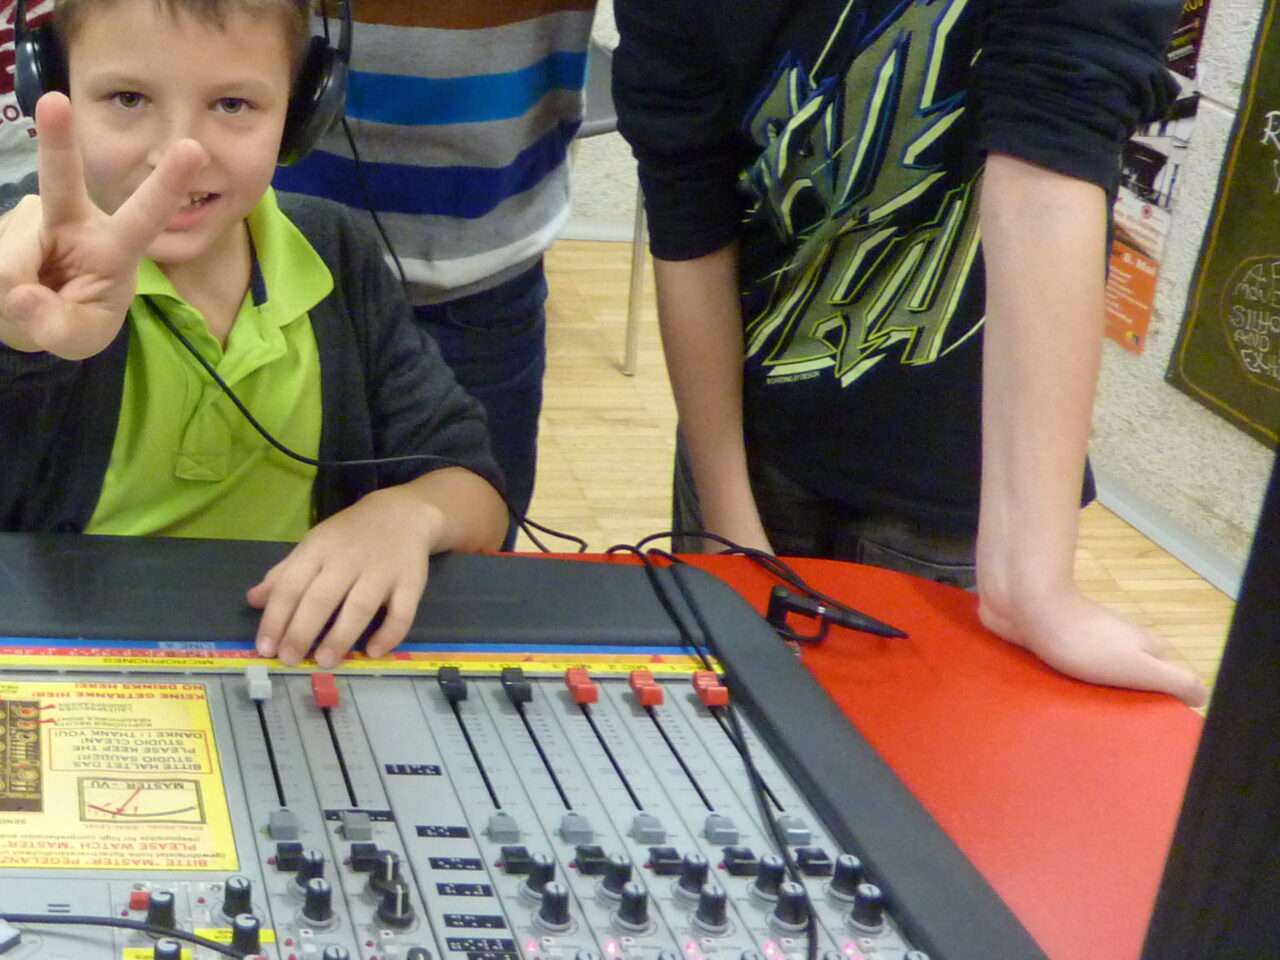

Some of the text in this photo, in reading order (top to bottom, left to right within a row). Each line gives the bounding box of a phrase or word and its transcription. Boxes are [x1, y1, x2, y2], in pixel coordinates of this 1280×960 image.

[122, 683, 177, 691] DRINKS
[75, 692, 155, 701] GETRÄNKE
[89, 730, 136, 738] THANK
[72, 744, 97, 752] THE
[143, 746, 196, 754] PLEASE
[77, 754, 139, 762] SAUBER!
[72, 761, 202, 771] BITTE HALTET DAS
[90, 781, 110, 789] VU
[126, 782, 184, 790] MASTER
[80, 842, 134, 850] WATCH
[137, 843, 197, 851] PLEASE
[166, 859, 208, 867] BITTE
